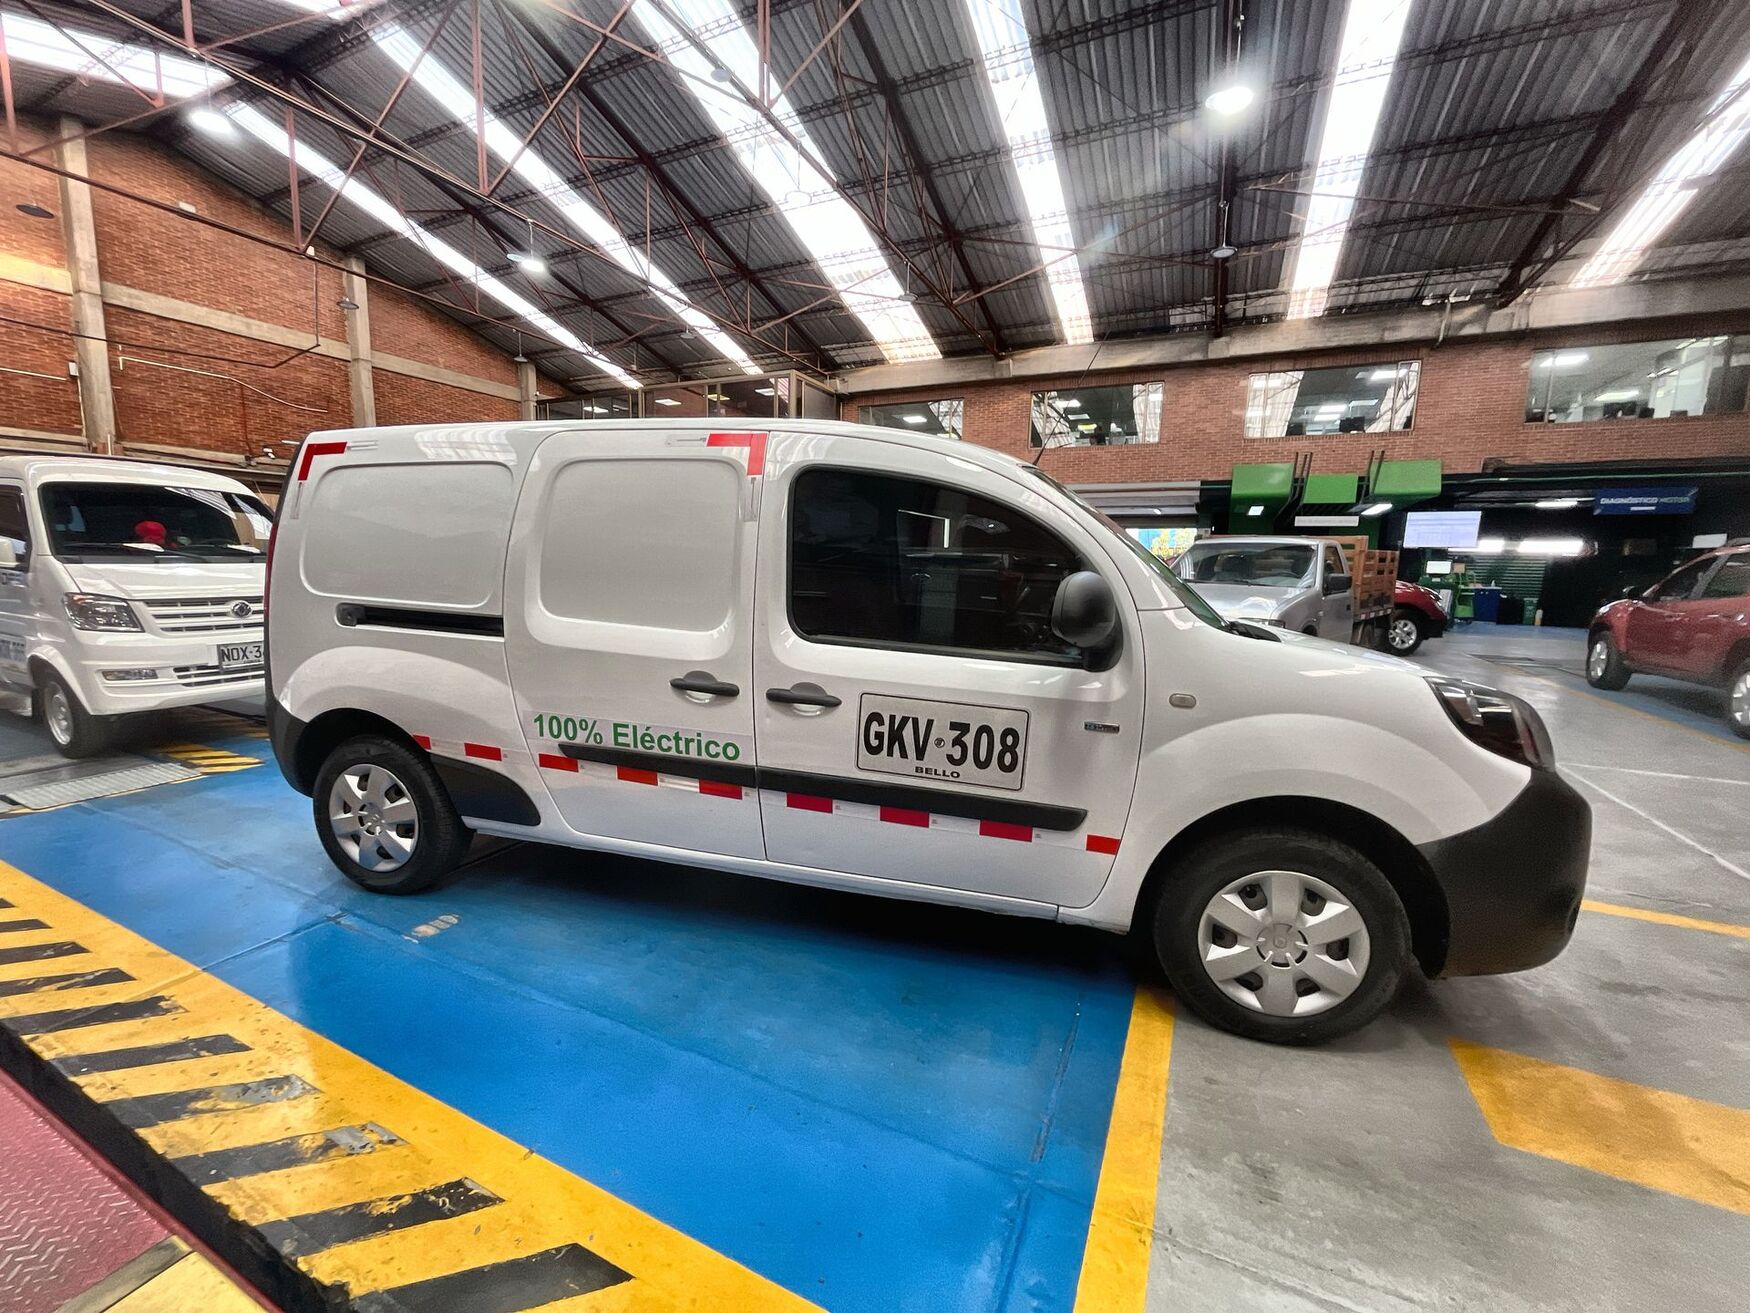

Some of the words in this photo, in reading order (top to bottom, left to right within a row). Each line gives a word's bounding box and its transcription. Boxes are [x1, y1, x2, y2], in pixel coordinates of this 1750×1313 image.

[220, 645, 265, 662] NOX-3
[533, 713, 604, 745] 100%
[612, 722, 741, 762] Eléctrico
[863, 711, 935, 762] GKV
[945, 720, 1020, 774] 308
[914, 766, 961, 779] BELLO
